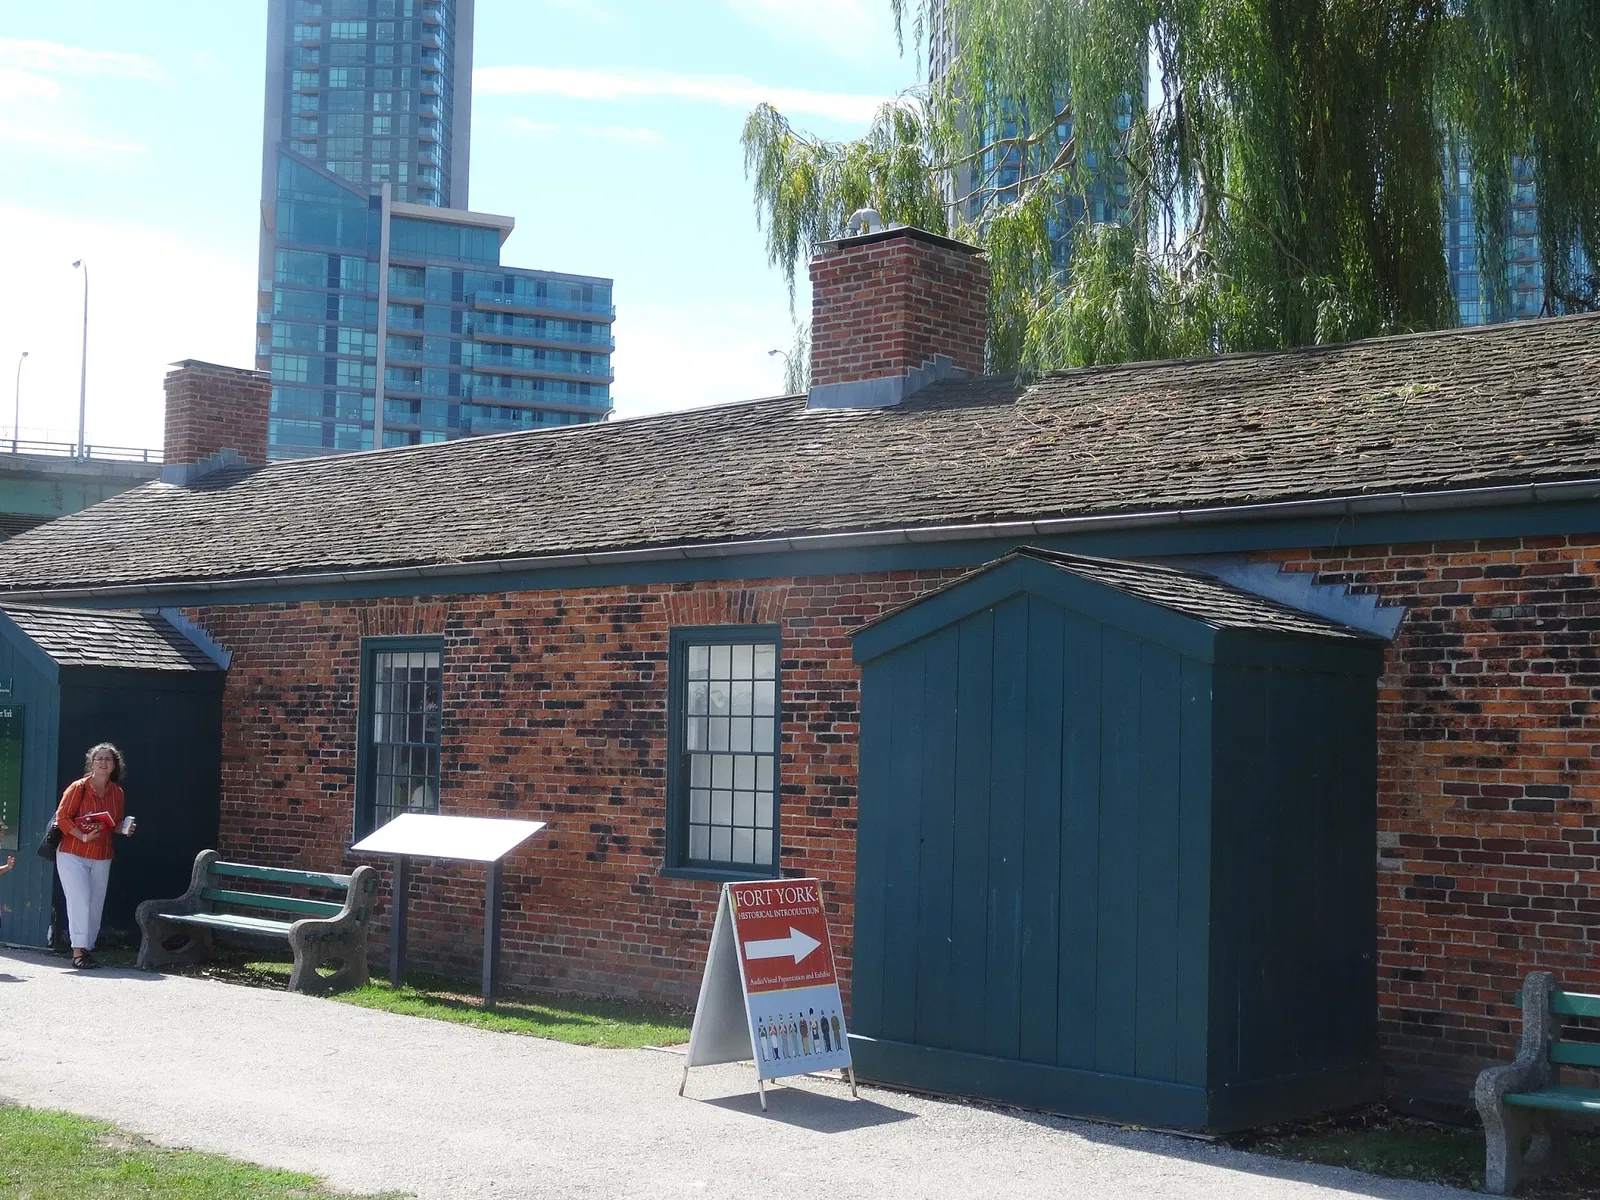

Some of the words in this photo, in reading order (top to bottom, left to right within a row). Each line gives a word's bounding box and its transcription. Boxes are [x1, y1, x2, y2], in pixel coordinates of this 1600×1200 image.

[735, 888, 773, 907] FORT
[776, 886, 819, 904] YORK:
[738, 910, 774, 920] HISTORICAL
[774, 906, 819, 918] INTRODUCTION
[778, 974, 805, 983] Presentation
